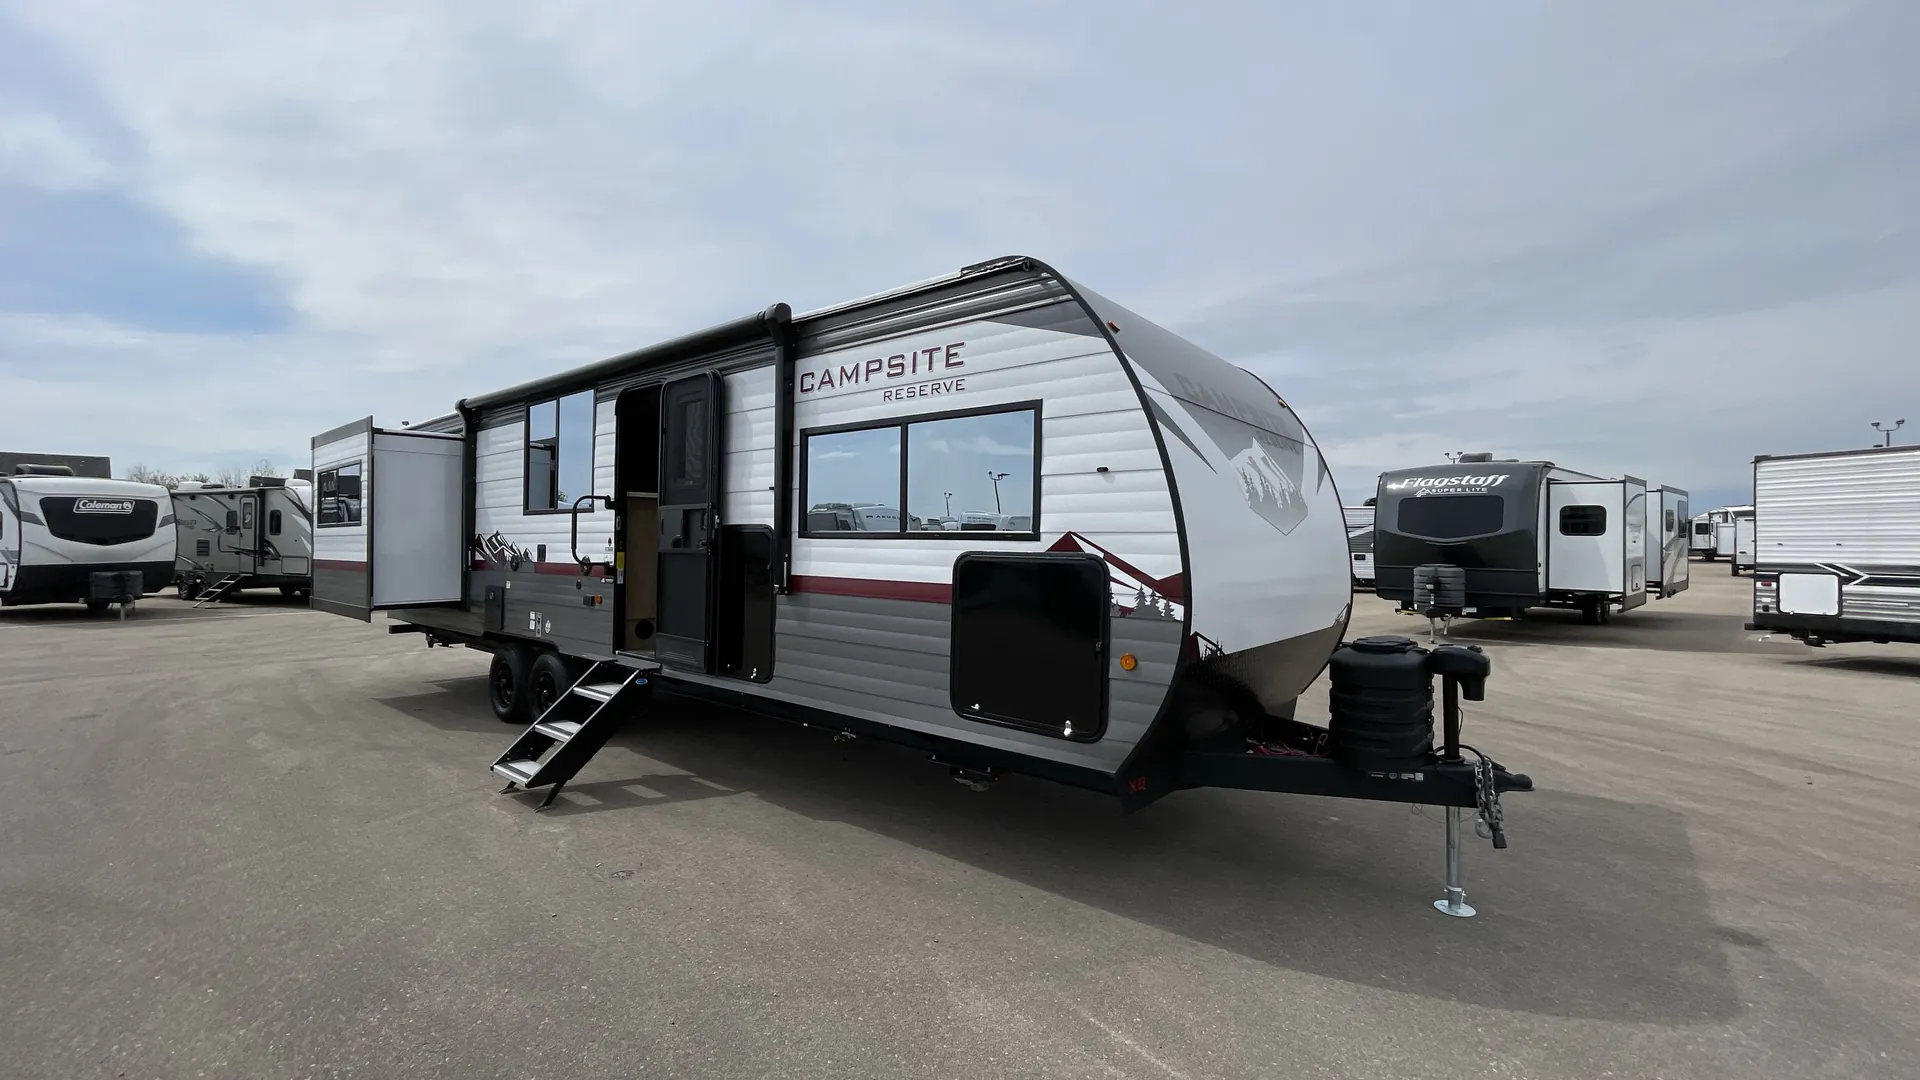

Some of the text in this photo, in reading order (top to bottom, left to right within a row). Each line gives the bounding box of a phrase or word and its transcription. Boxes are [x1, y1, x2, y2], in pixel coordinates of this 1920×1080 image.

[800, 341, 966, 393] CAMPSITE
[883, 378, 966, 402] RESERVE
[1402, 474, 1510, 488] Flagstaff
[79, 499, 122, 509] Coleman
